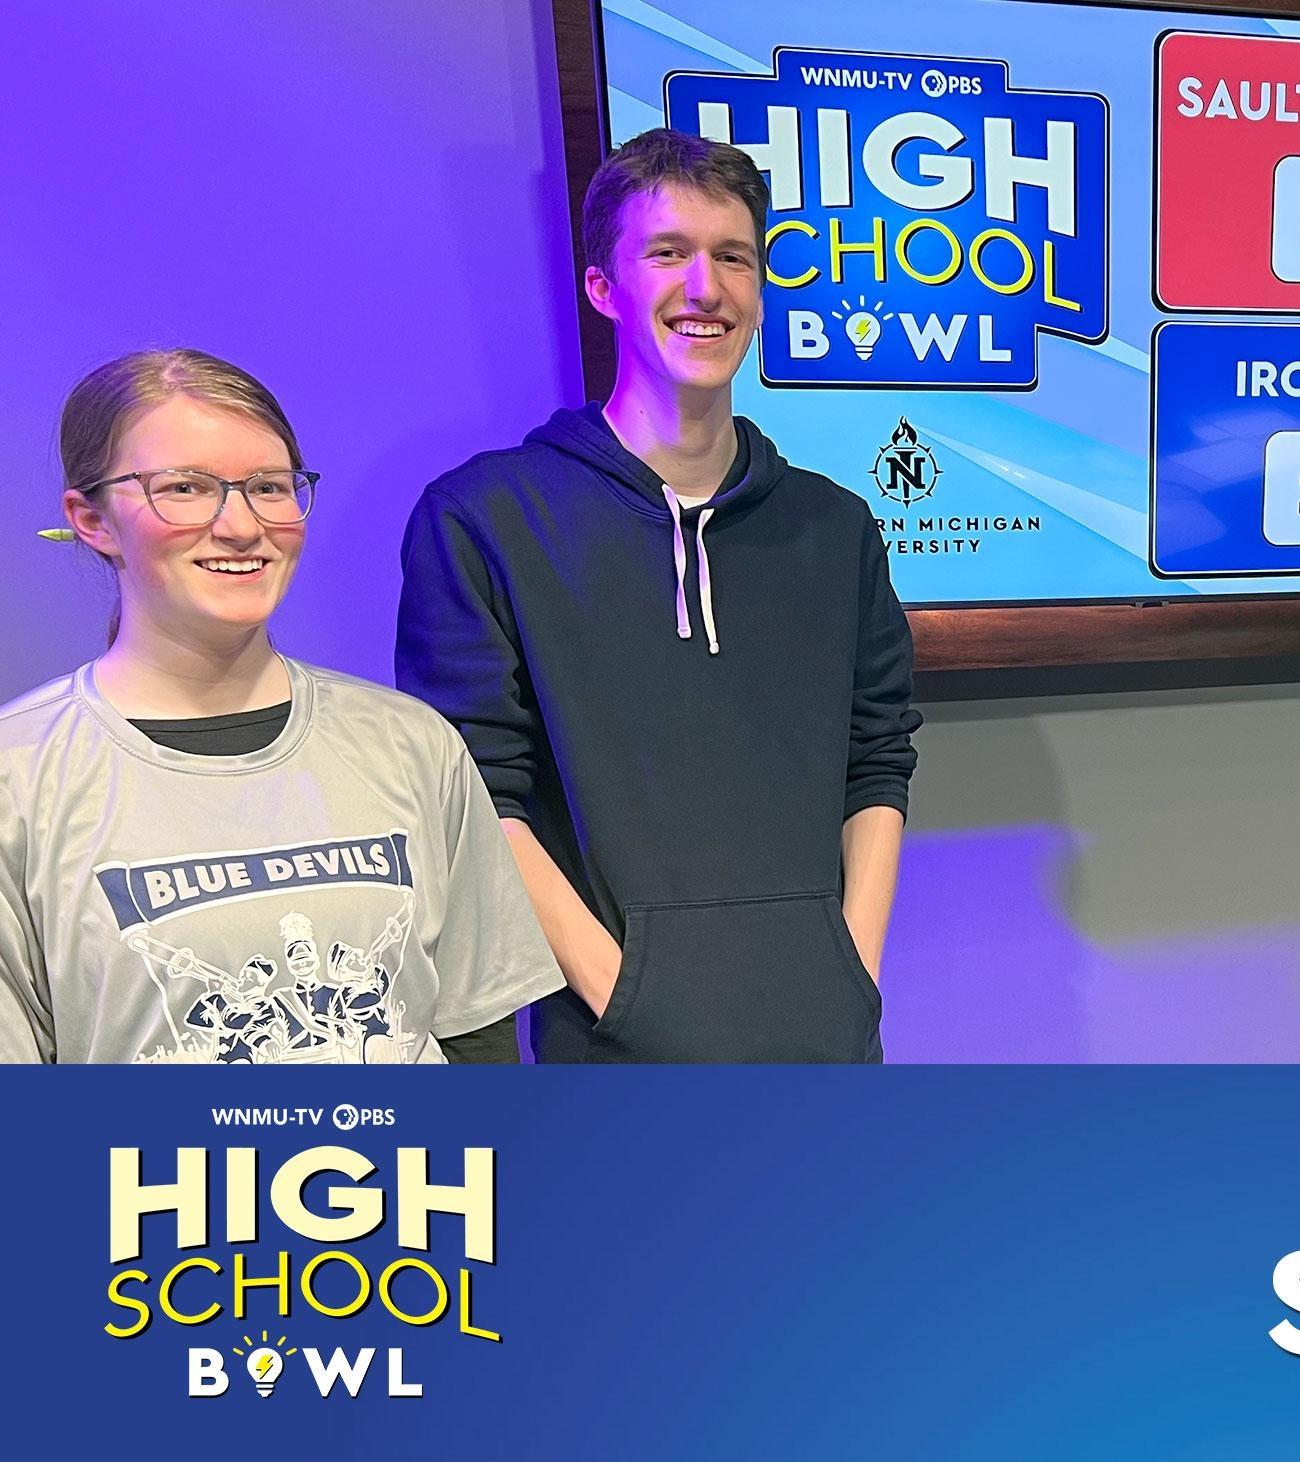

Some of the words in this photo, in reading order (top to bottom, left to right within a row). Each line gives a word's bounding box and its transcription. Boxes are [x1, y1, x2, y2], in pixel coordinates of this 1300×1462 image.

[801, 67, 912, 91] WNMU-TV
[948, 76, 983, 95] PBS
[698, 102, 1076, 237] HIGH
[765, 216, 1081, 312] CHOOL
[885, 539, 980, 554] VERSITY
[919, 517, 1041, 532] MICHIGAN
[143, 861, 250, 911] BLUE
[263, 842, 391, 883] DEVILS
